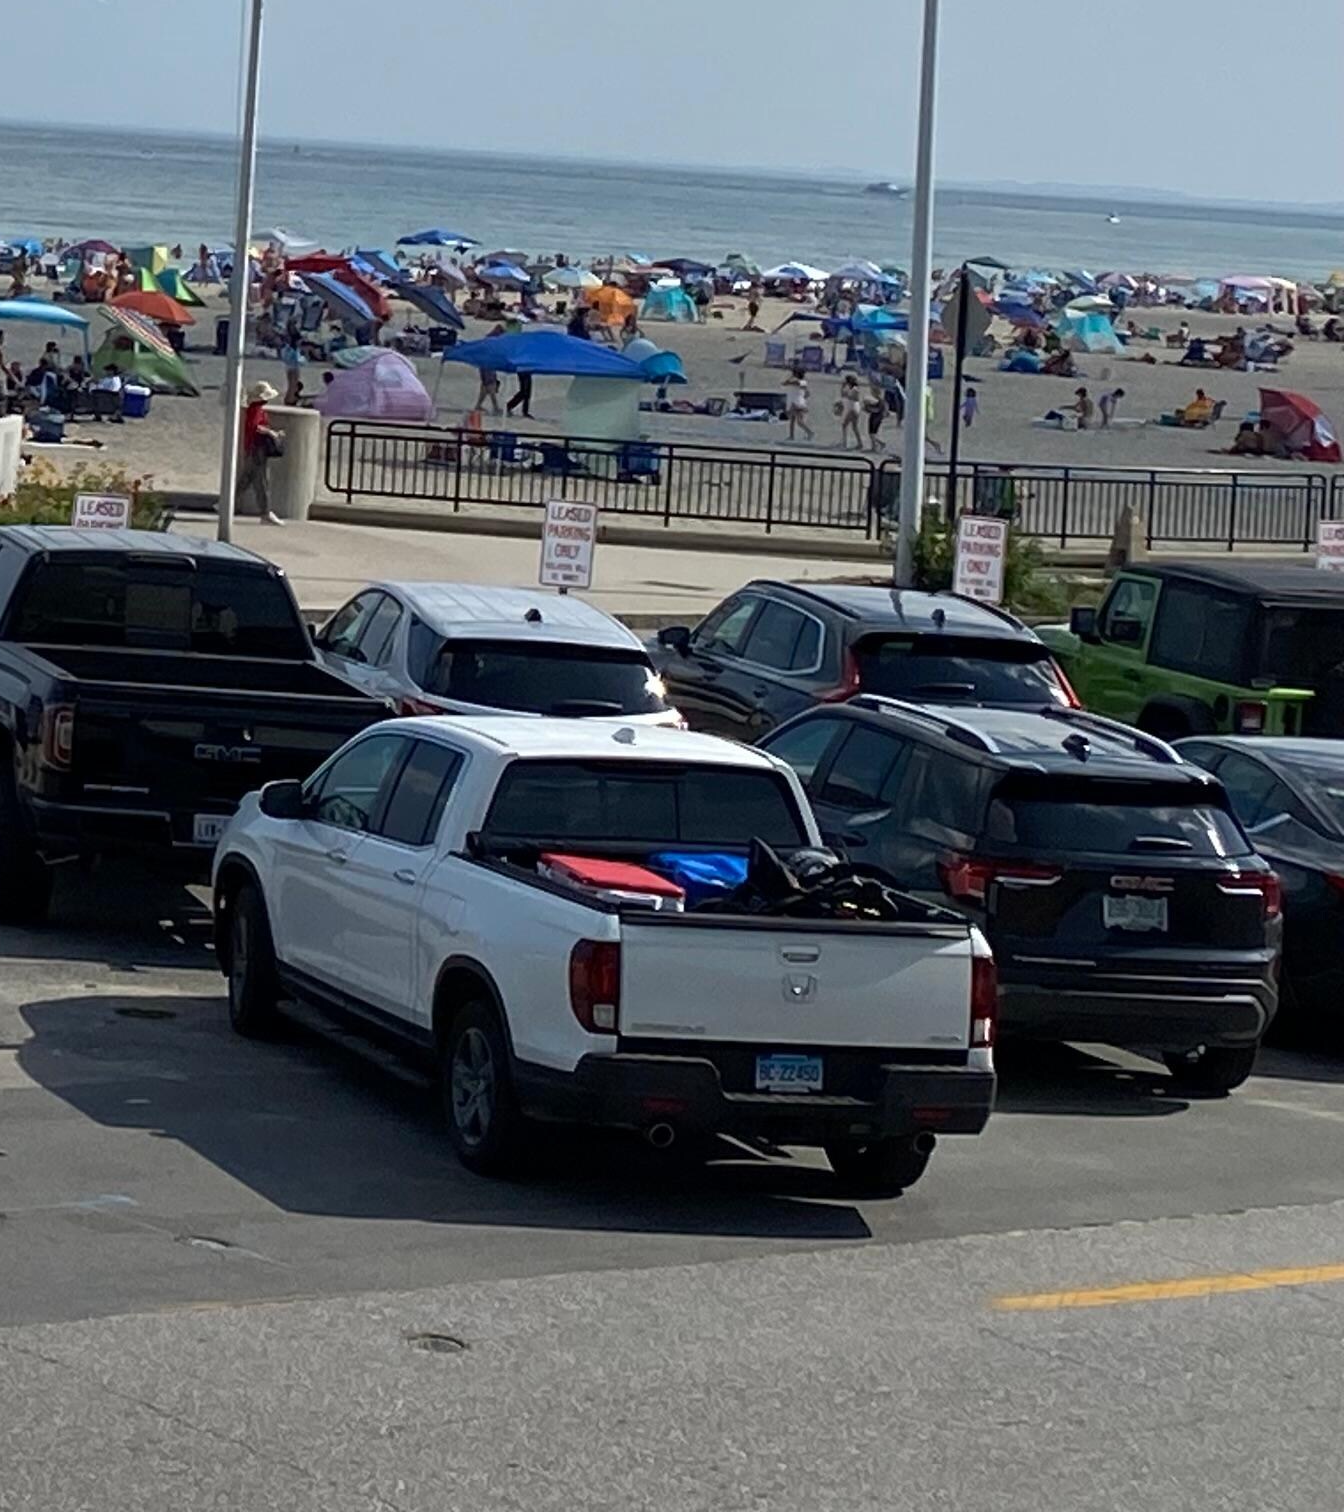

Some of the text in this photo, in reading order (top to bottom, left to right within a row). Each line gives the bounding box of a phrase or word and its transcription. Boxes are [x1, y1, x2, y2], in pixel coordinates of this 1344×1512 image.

[80, 500, 125, 517] LEASED
[551, 506, 591, 522] LEASED
[547, 524, 591, 542] PARKING
[964, 522, 1001, 540] LEASED
[555, 543, 580, 559] ONLY
[961, 541, 1001, 558] PARKING
[967, 559, 991, 575] ONLY
[194, 743, 262, 763] GMC
